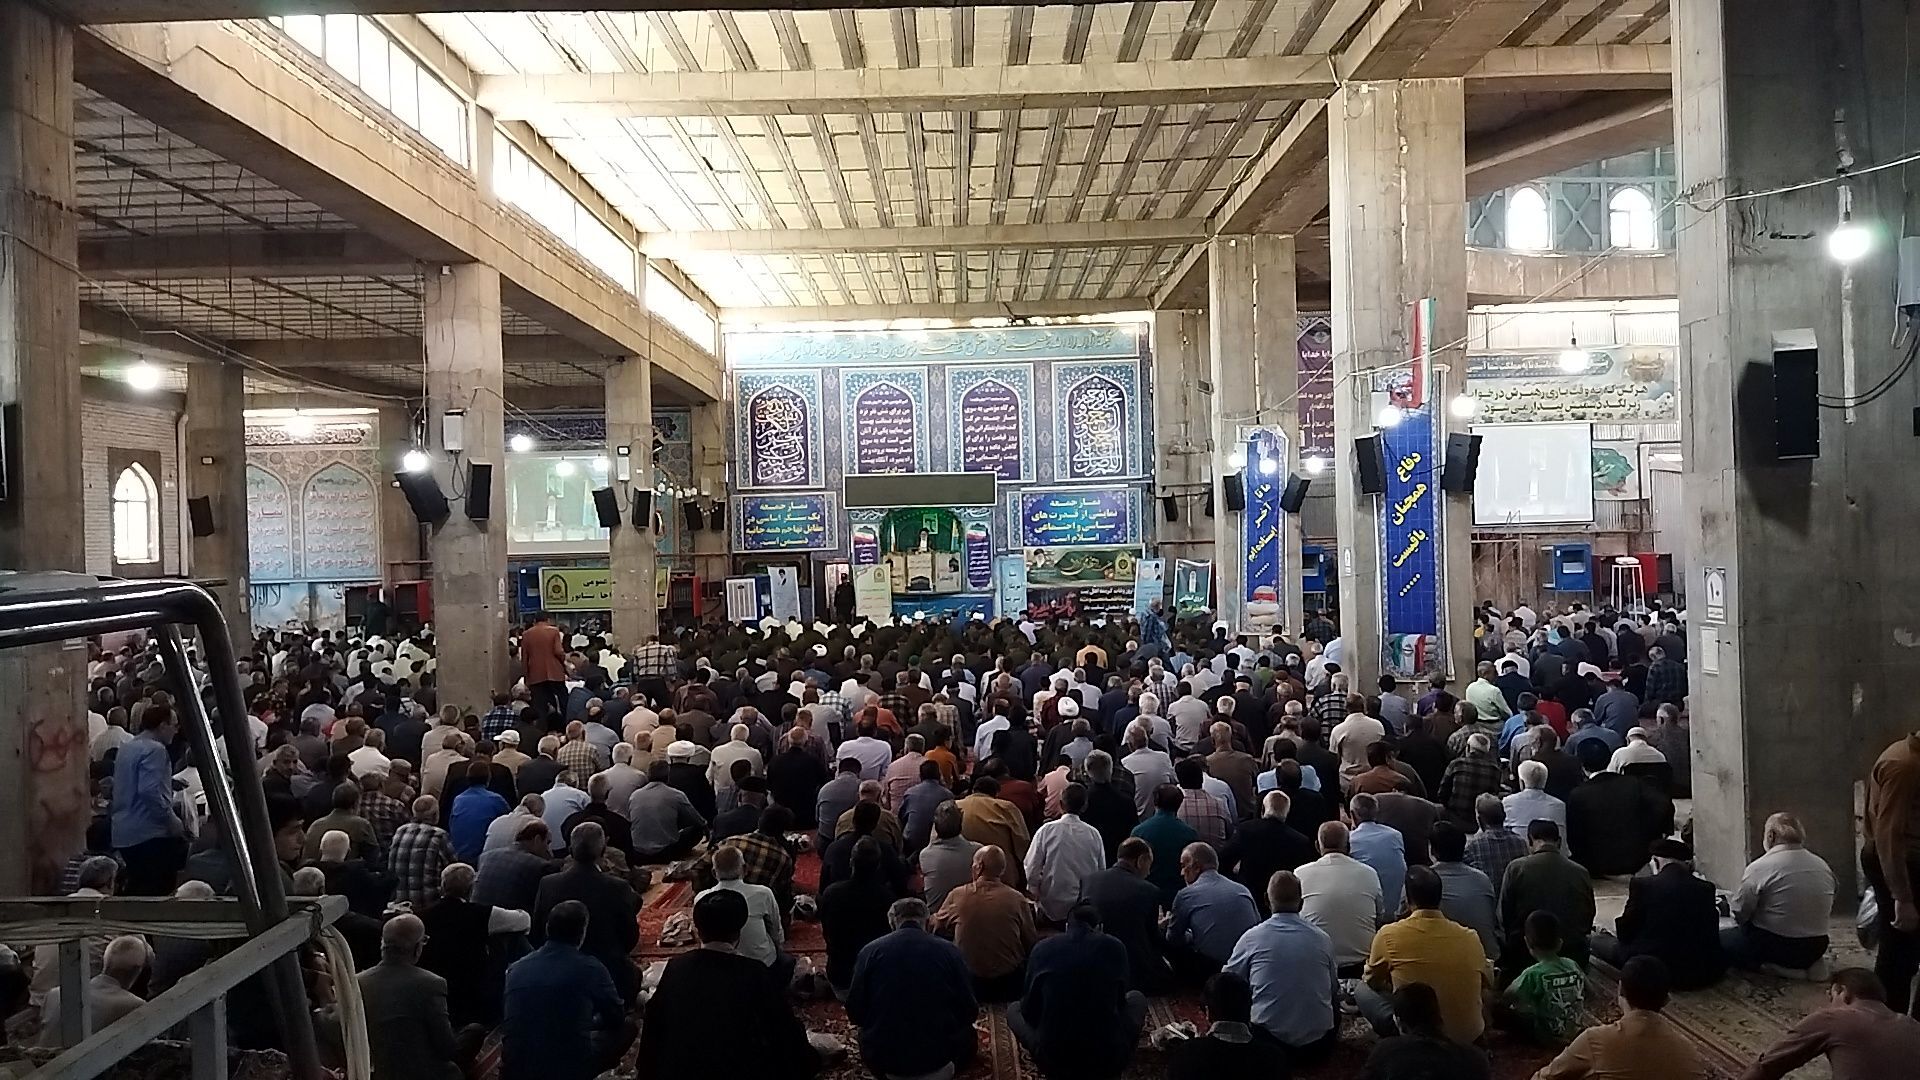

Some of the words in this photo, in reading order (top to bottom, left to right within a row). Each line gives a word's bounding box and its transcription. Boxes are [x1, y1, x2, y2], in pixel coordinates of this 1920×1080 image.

[1397, 452, 1421, 483] دفاع
[787, 501, 808, 512] نماز
[1049, 499, 1078, 507] جمعه
[1079, 497, 1101, 508] نماز
[1392, 483, 1427, 526] همچنان
[1088, 509, 1118, 520] نمایشی
[1081, 521, 1116, 531] سیاسی
[1071, 533, 1099, 543] اسلام
[1392, 529, 1430, 568] باقیست
